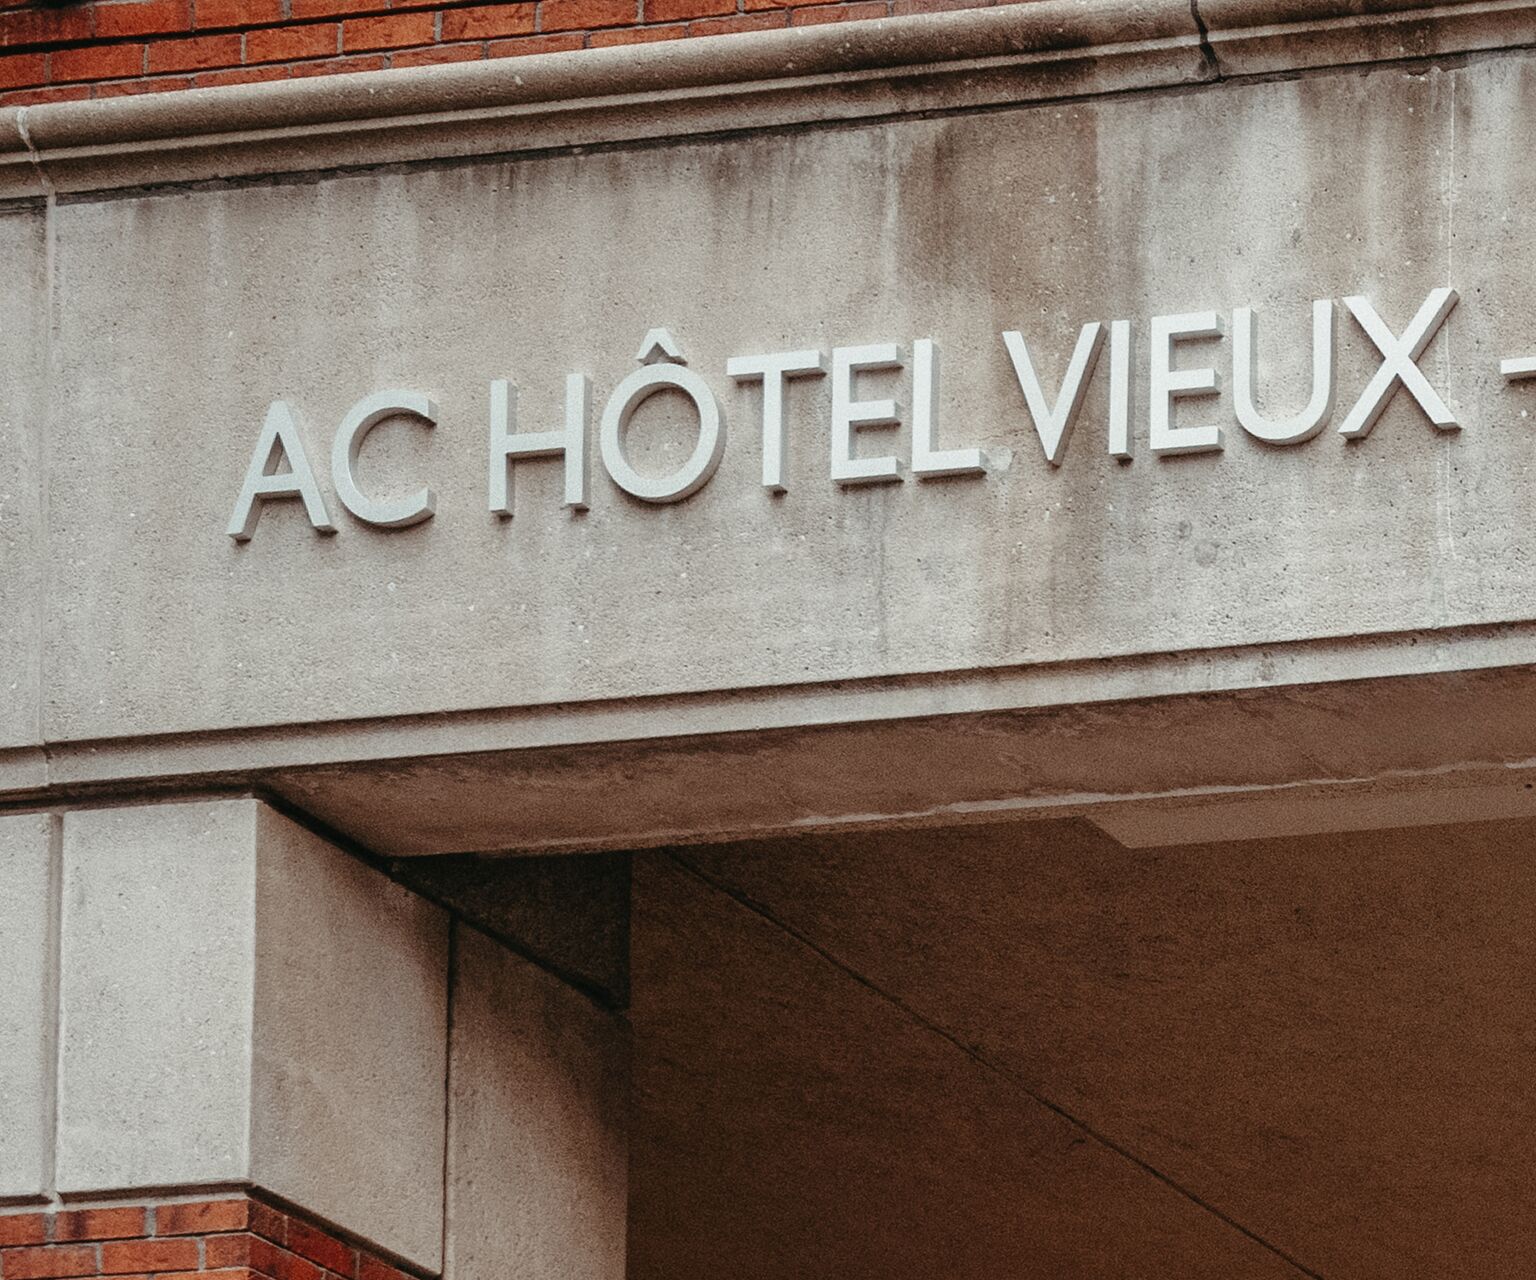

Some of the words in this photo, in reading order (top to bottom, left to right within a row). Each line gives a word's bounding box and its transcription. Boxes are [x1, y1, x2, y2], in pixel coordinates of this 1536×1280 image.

[226, 388, 438, 542] AC
[487, 327, 988, 518] HÔTEL
[1001, 287, 1461, 468] VIEUX
